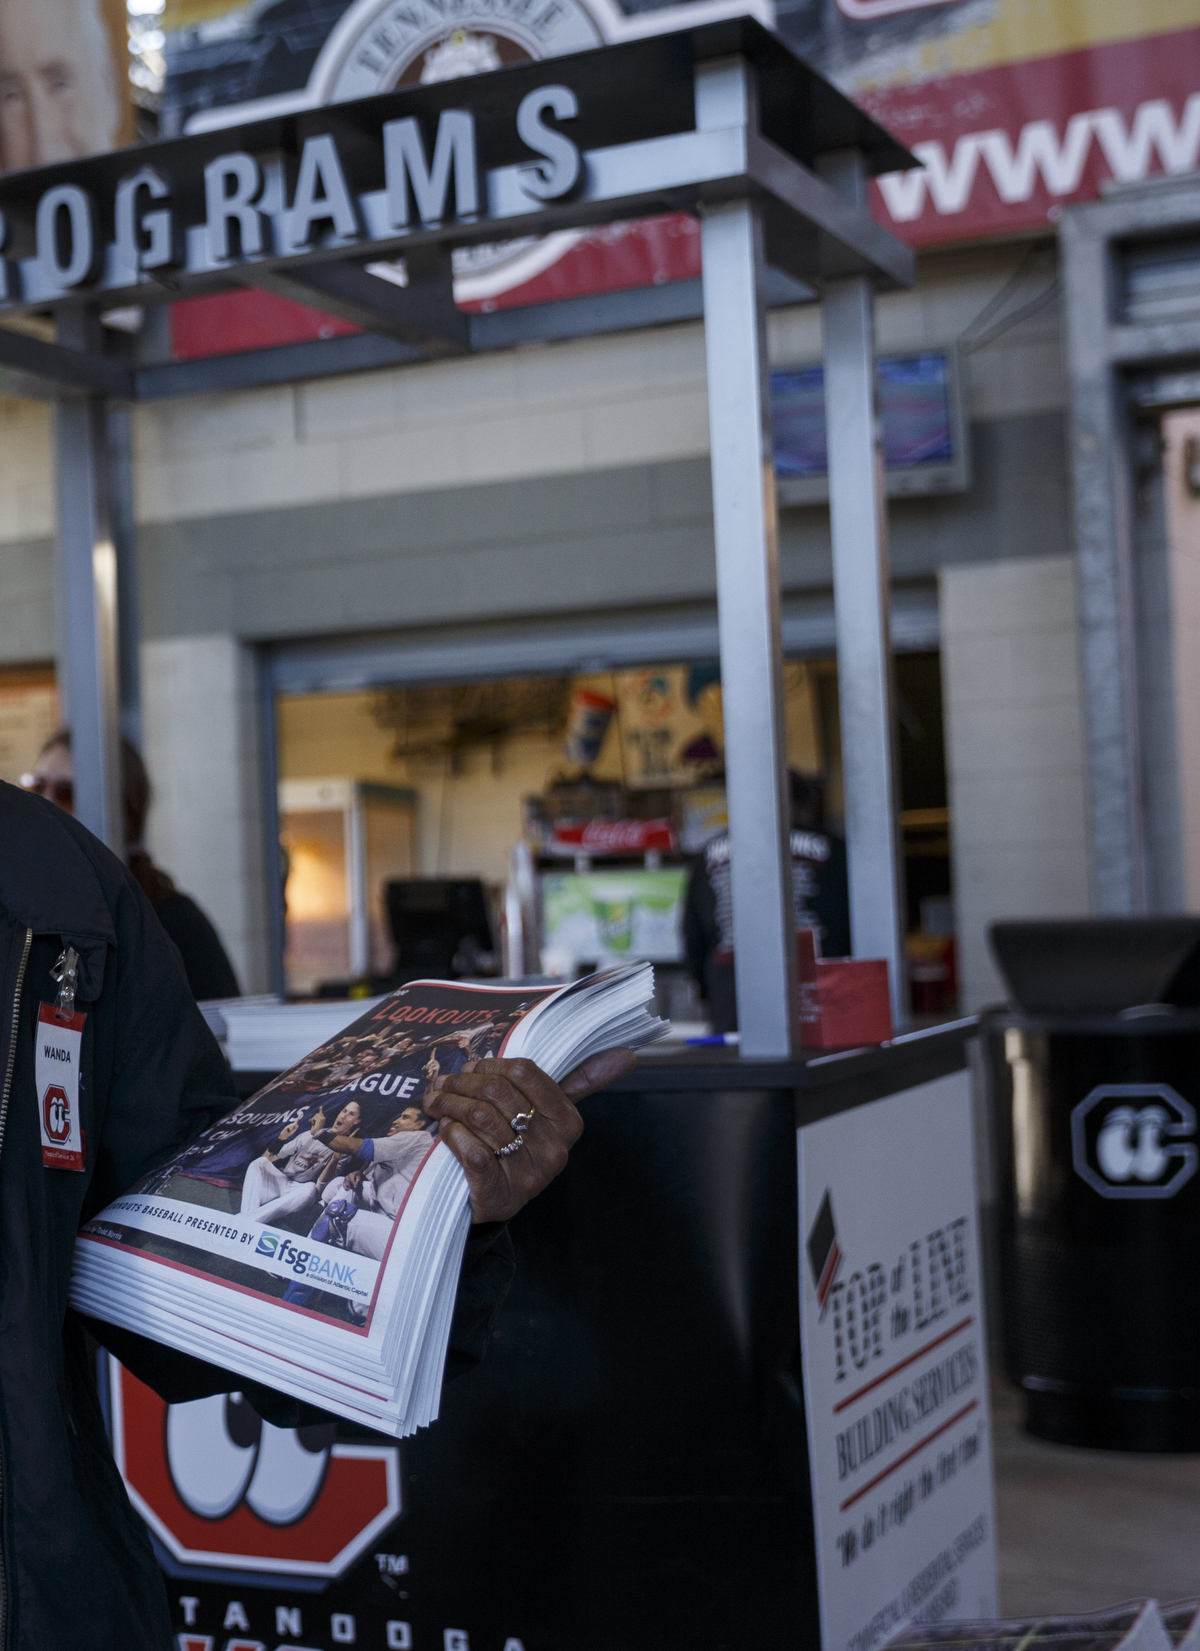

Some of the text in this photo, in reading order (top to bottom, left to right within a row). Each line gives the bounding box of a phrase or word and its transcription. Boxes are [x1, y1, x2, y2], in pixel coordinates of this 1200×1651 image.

[371, 1000, 500, 1024] LOOKOUTS
[44, 1045, 71, 1063] WANDA
[141, 1205, 182, 1224] BASEBALL
[185, 1216, 238, 1240] PRESENTED
[240, 1232, 254, 1245] BY
[278, 1239, 357, 1286] fsgBANK
[310, 1273, 328, 1284] division
[333, 1281, 351, 1292] Atlantic
[351, 1287, 369, 1297] Capital
[831, 1262, 885, 1383] TOP
[835, 1340, 977, 1481] BUILDING SERVICES
[375, 1554, 409, 1574] TM
